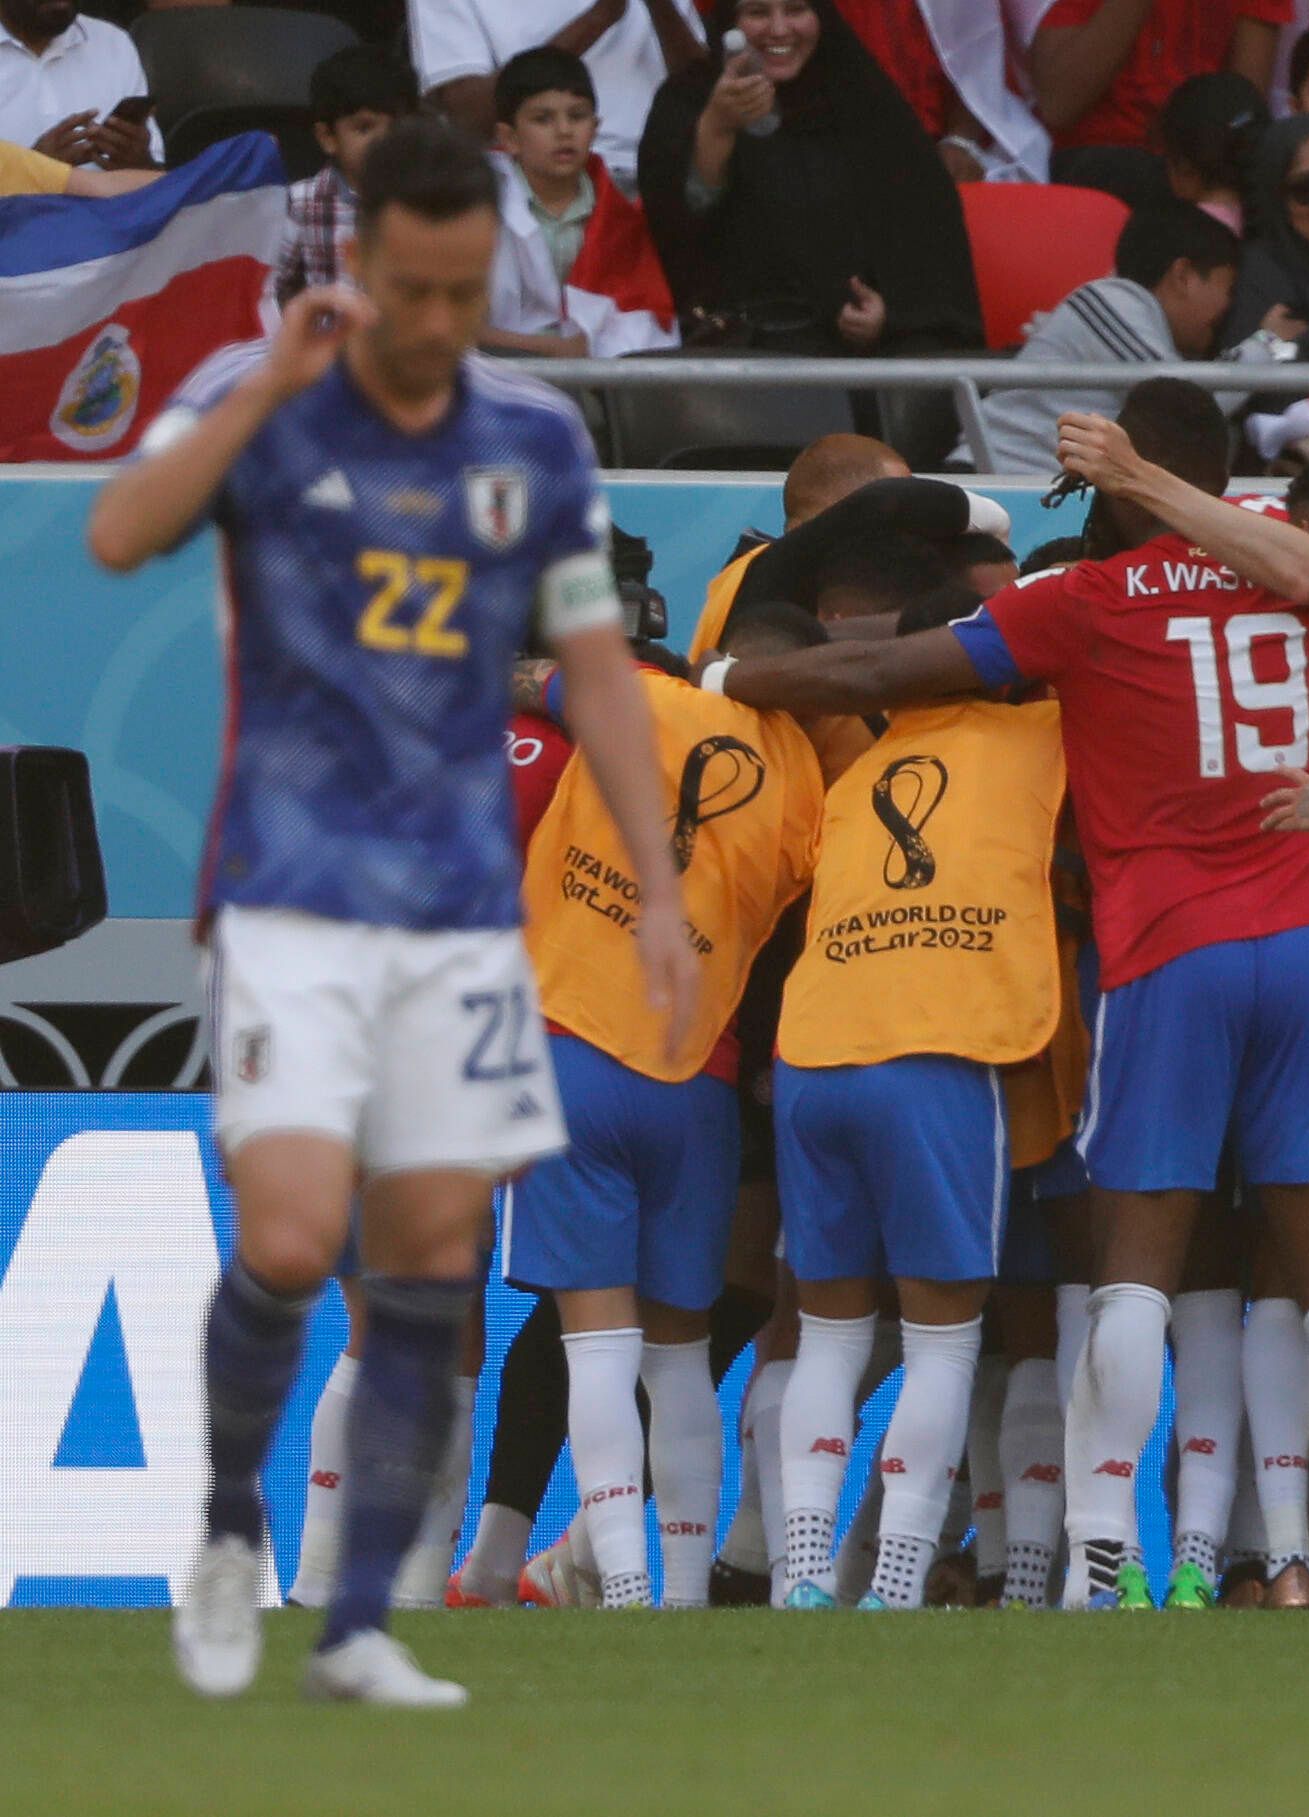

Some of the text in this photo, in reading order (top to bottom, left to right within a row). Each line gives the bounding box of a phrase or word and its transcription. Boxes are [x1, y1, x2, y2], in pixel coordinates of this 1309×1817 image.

[1126, 561, 1254, 597] K. WAS
[356, 551, 469, 658] 22
[564, 845, 601, 881] FIFA
[866, 905, 957, 928] WORLD
[960, 907, 1006, 925] CUP
[825, 927, 994, 964] Qatar2022
